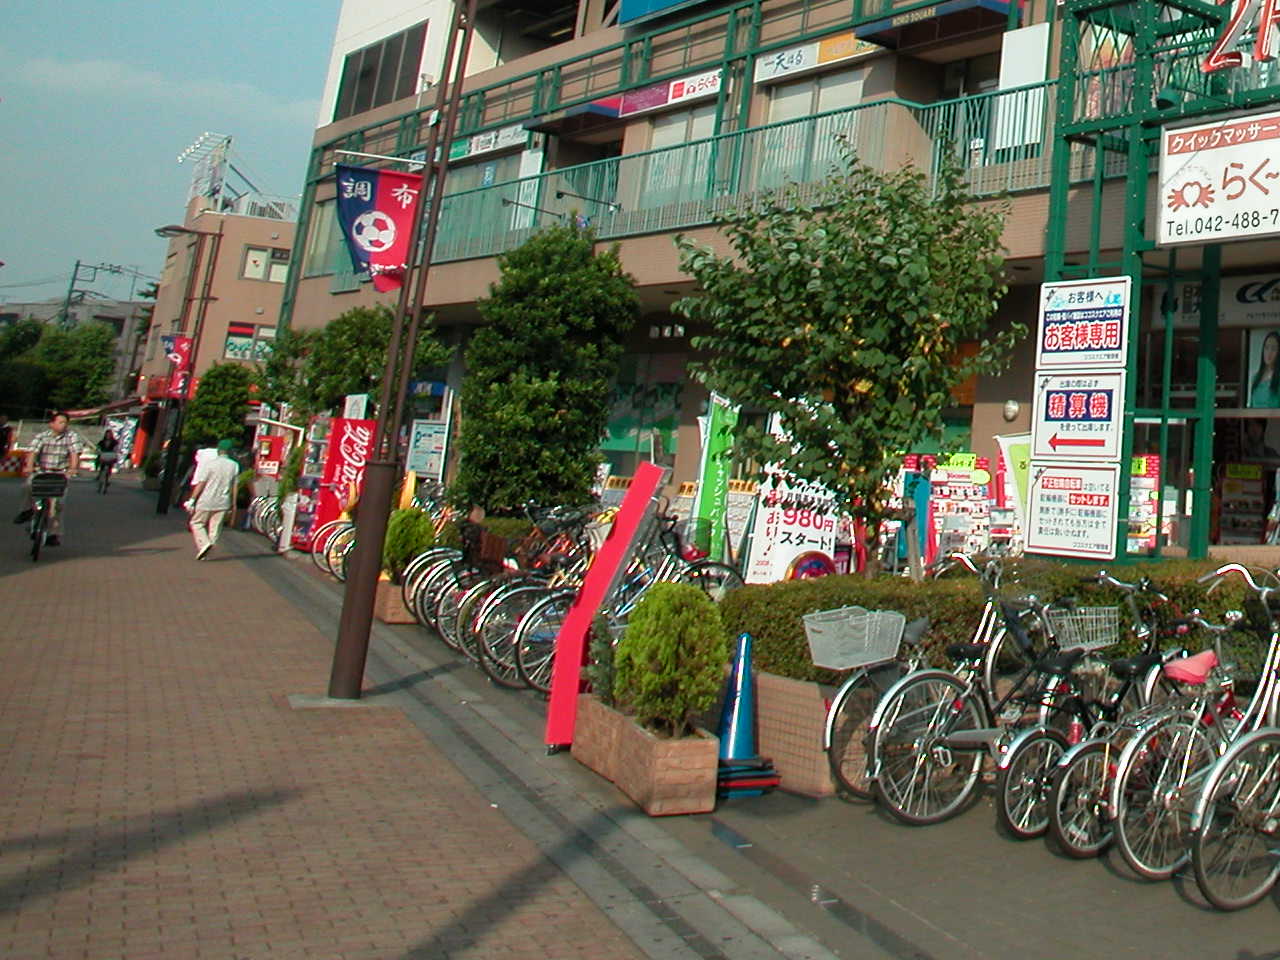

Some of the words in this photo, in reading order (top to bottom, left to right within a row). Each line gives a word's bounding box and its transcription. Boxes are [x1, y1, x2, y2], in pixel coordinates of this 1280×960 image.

[341, 178, 419, 209] 調布
[1068, 290, 1104, 304] お客様へ
[1044, 321, 1120, 350] お客様専用
[1047, 393, 1109, 418] 精算機
[783, 507, 834, 533] 980円
[780, 530, 832, 552] スタート!
